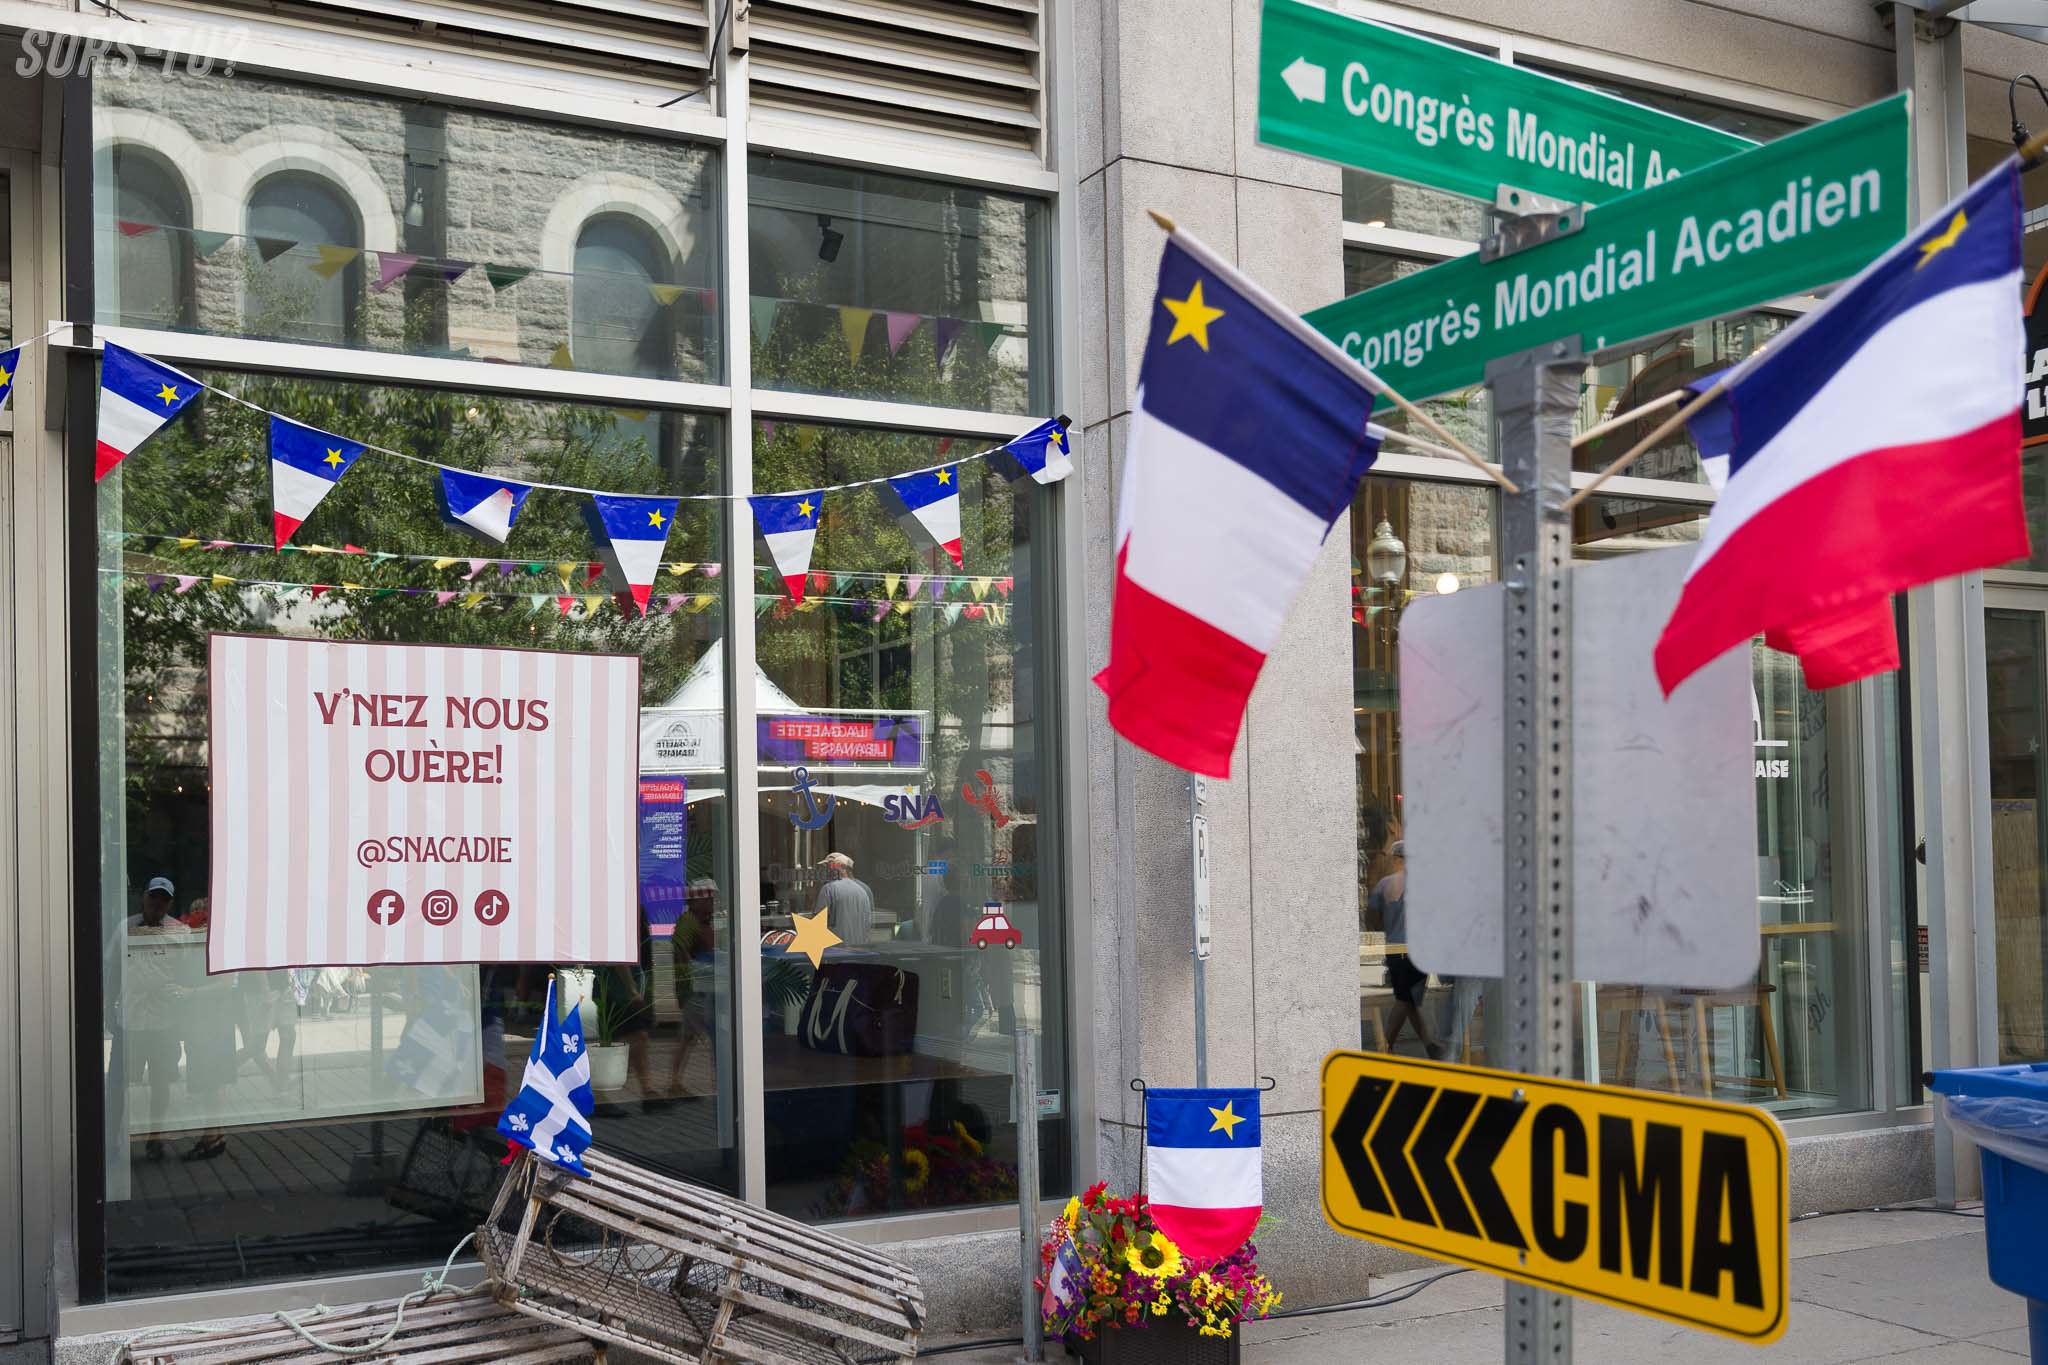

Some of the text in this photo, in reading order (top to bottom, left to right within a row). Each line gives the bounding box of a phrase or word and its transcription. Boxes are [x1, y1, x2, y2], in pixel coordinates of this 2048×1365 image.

[1342, 61, 1495, 152] Congrès
[1506, 107, 1634, 191] Mondial
[1342, 168, 1881, 370] Congrès Mondial Acadien
[314, 688, 549, 732] V’NEZ NOUS
[365, 739, 503, 784] OUÈRE!
[883, 794, 944, 822] SNA
[357, 836, 512, 869] @SNACADIE
[972, 864, 1038, 877] Bruns
[1530, 1103, 1765, 1311] CMA
